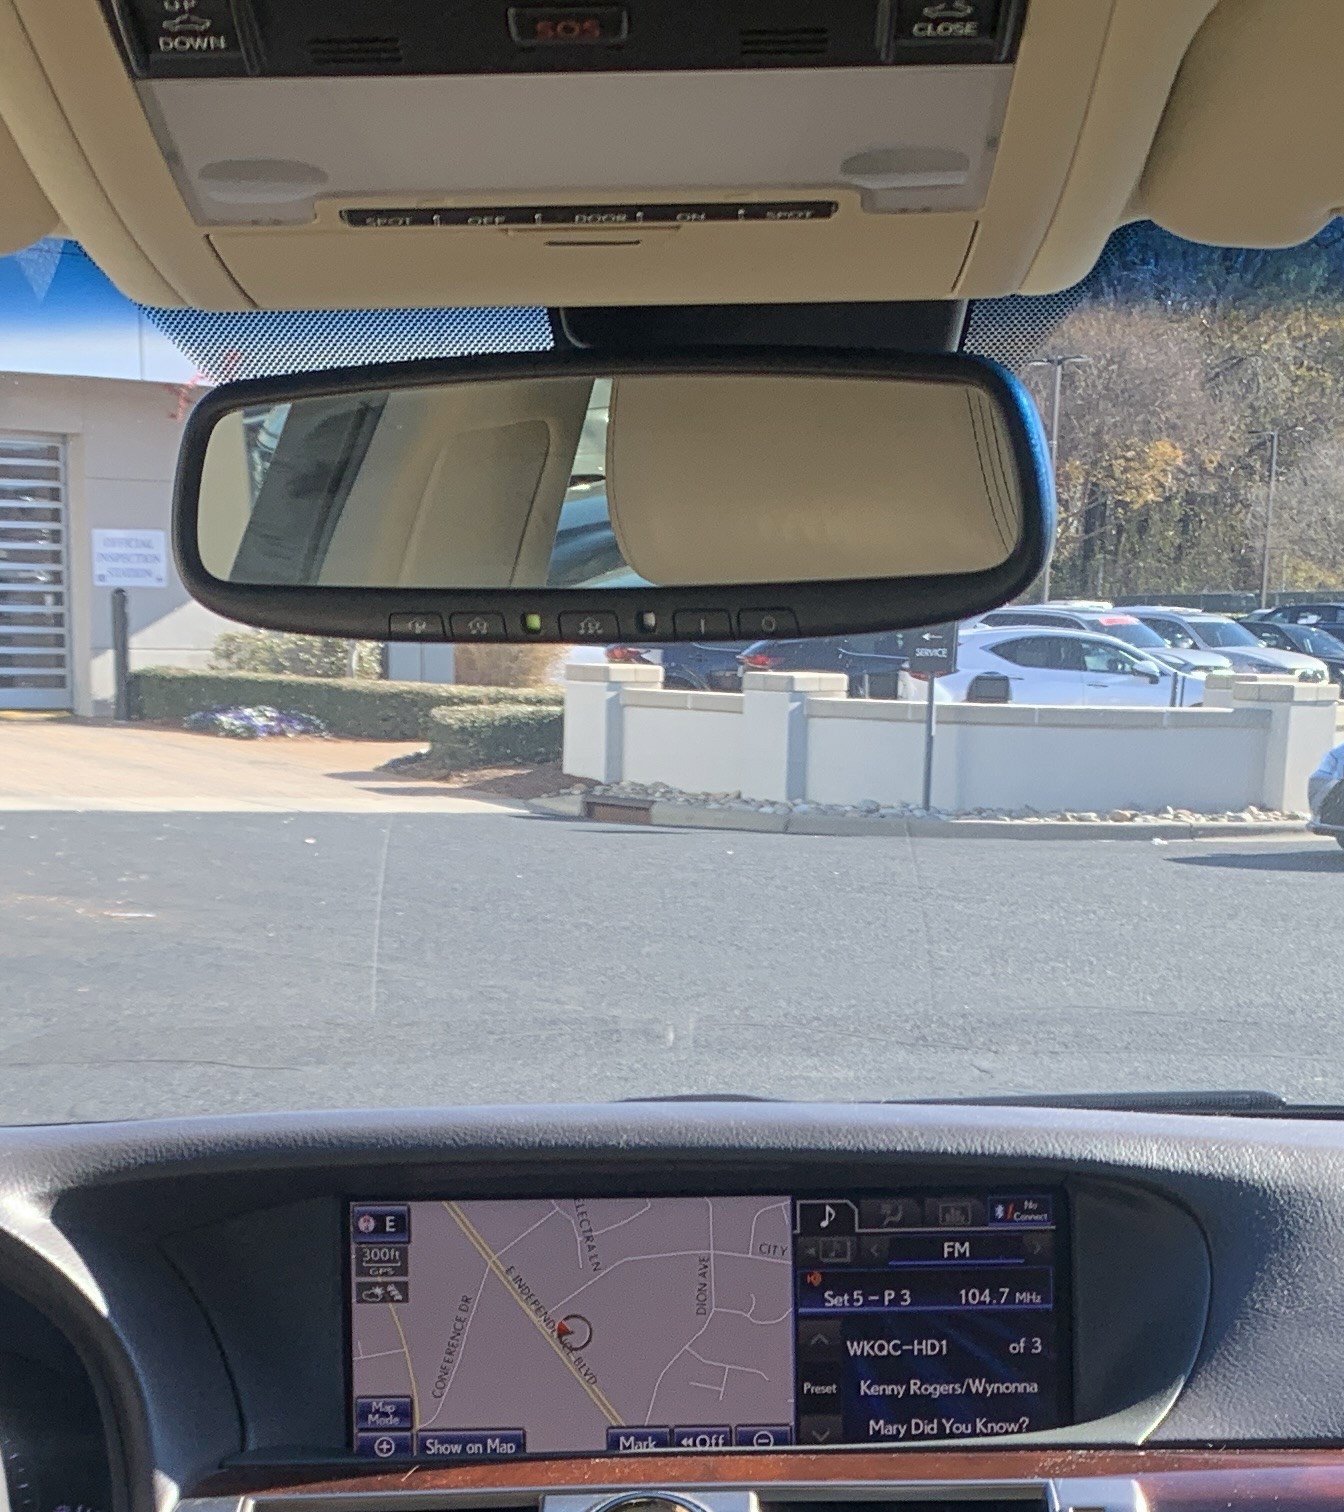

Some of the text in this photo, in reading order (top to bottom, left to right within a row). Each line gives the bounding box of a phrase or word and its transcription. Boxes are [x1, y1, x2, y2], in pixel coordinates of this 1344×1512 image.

[536, 19, 601, 39] SOS
[912, 21, 978, 37] CLOSE
[159, 35, 226, 52] DOWN
[915, 647, 948, 658] SERVICE
[385, 1215, 397, 1233] E
[362, 1248, 401, 1261] 300ft
[758, 1243, 788, 1257] CITY
[943, 1241, 971, 1259] FM
[369, 1267, 395, 1276] GPS
[696, 1256, 711, 1316] DION AVE
[824, 1289, 850, 1307] Set
[852, 1289, 864, 1307] 5
[884, 1289, 895, 1307] P
[901, 1289, 912, 1306] 3
[958, 1287, 1010, 1305] 104.7
[1015, 1291, 1042, 1304] MHz
[431, 1294, 473, 1400] CONFERENCE DR
[846, 1337, 1043, 1357] WKQC-HD1 of 3
[572, 1356, 598, 1386] BLVD
[803, 1382, 837, 1395] Preset
[859, 1376, 1039, 1399] Kenny Rogers/Wynonna
[371, 1401, 396, 1414] Map
[367, 1414, 400, 1426] Mode
[869, 1416, 1029, 1438] Mary Did You Know?
[425, 1437, 516, 1455] Show on Map
[619, 1435, 657, 1450] Mark
[696, 1433, 725, 1447] Off
